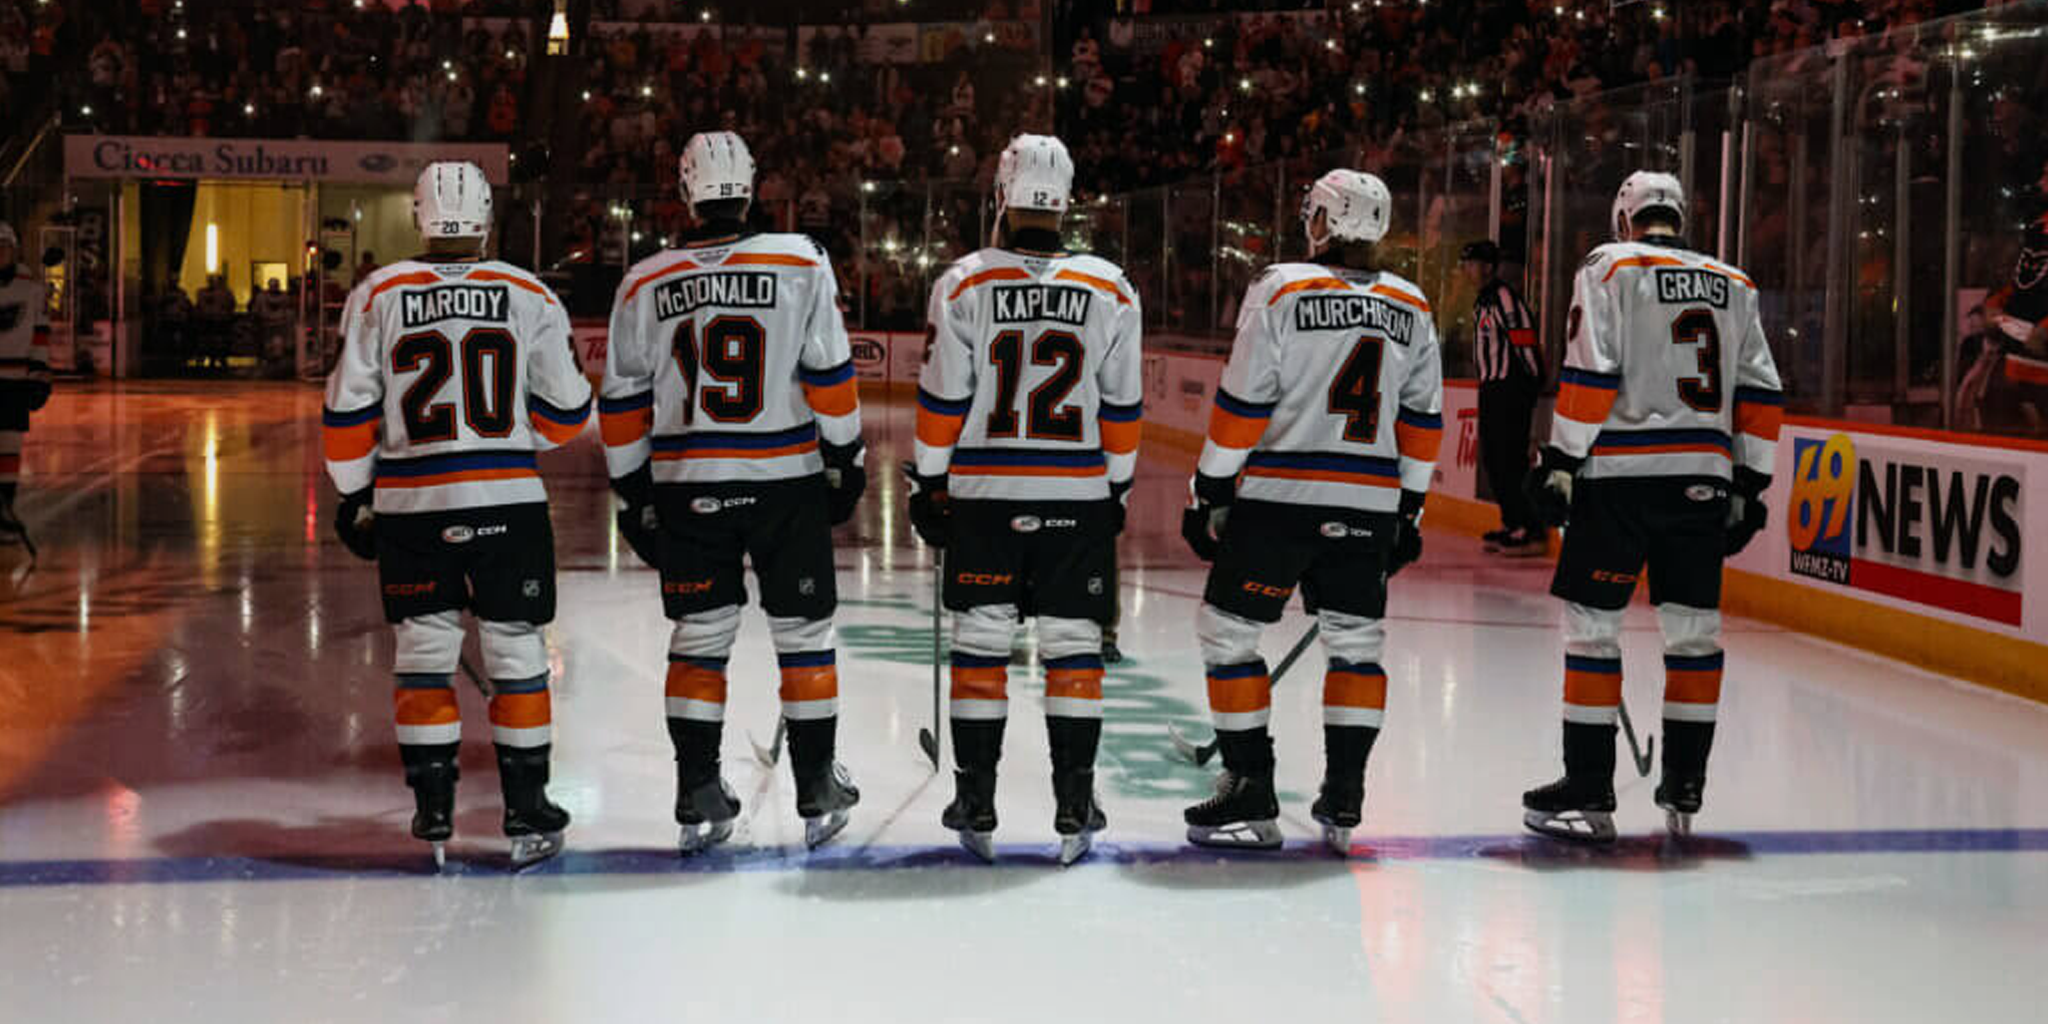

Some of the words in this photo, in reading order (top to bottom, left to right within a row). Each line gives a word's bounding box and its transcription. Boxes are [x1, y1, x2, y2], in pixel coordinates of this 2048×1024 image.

[93, 141, 204, 172] Ciocca
[215, 144, 328, 175] Subaru
[720, 183, 733, 196] 19
[1033, 191, 1047, 206] 12
[441, 221, 459, 234] 20
[404, 287, 505, 324] MARODY
[657, 275, 773, 318] McDONALD
[995, 288, 1086, 322] KAPLAN
[671, 315, 765, 425] 19
[1671, 308, 1721, 413] 3
[392, 328, 517, 443] 20
[987, 330, 1085, 441] 12
[1328, 336, 1384, 443] 4
[1789, 434, 1856, 551] 69
[1858, 459, 2020, 578] NEWS
[957, 573, 1012, 586] CCM
[1793, 552, 1849, 584] WFMZ-TV
